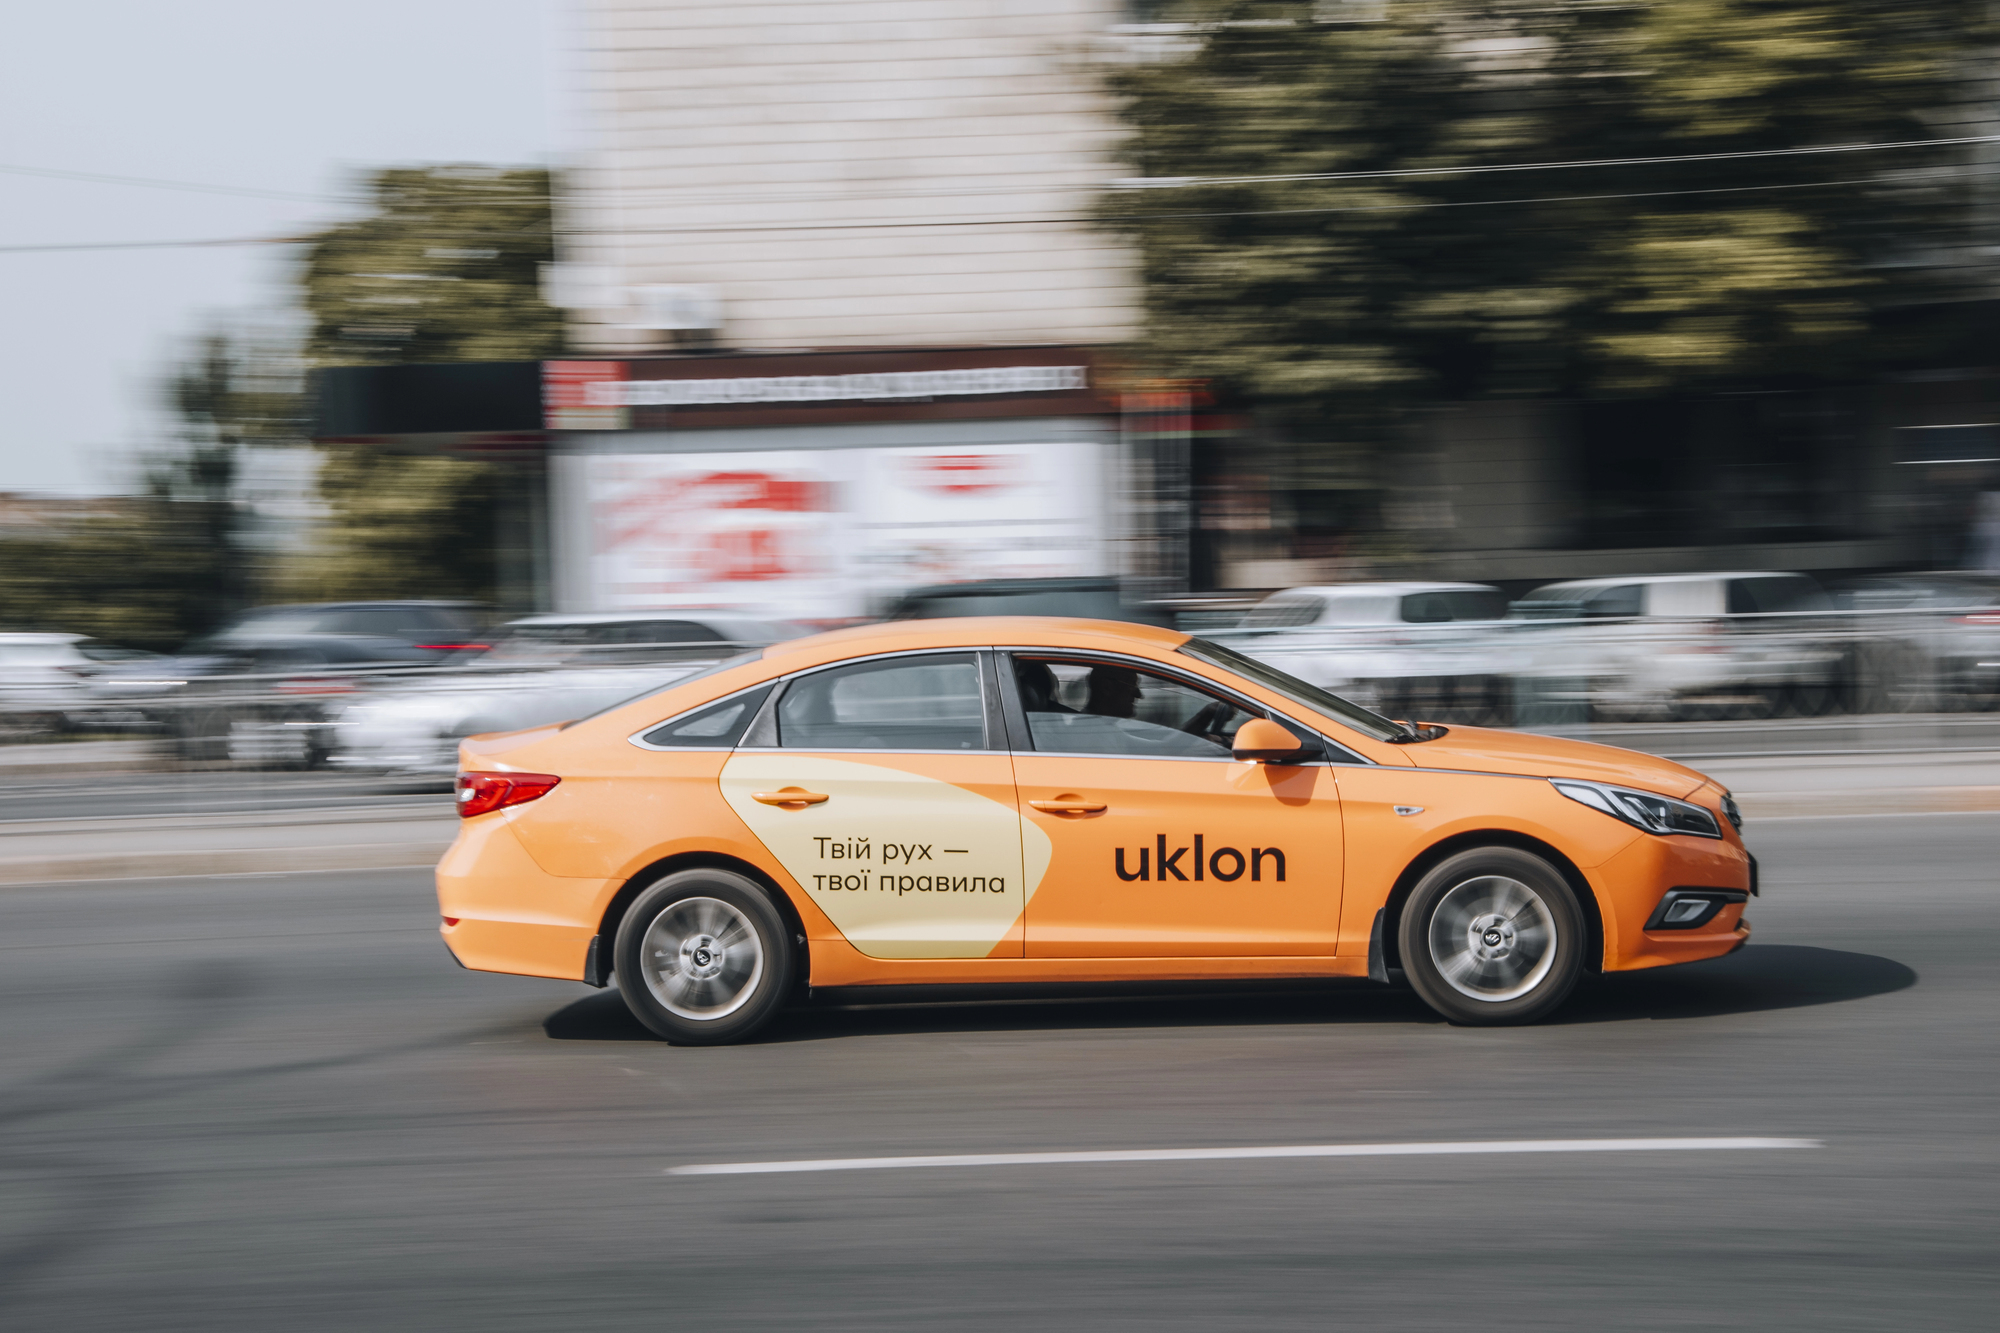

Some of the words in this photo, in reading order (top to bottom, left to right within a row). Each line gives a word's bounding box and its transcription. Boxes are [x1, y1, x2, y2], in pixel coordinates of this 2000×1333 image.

[813, 837, 871, 860] Твій
[883, 843, 933, 865] рух
[1115, 834, 1286, 882] uklon
[813, 869, 871, 892] твої
[880, 875, 1005, 896] правила
